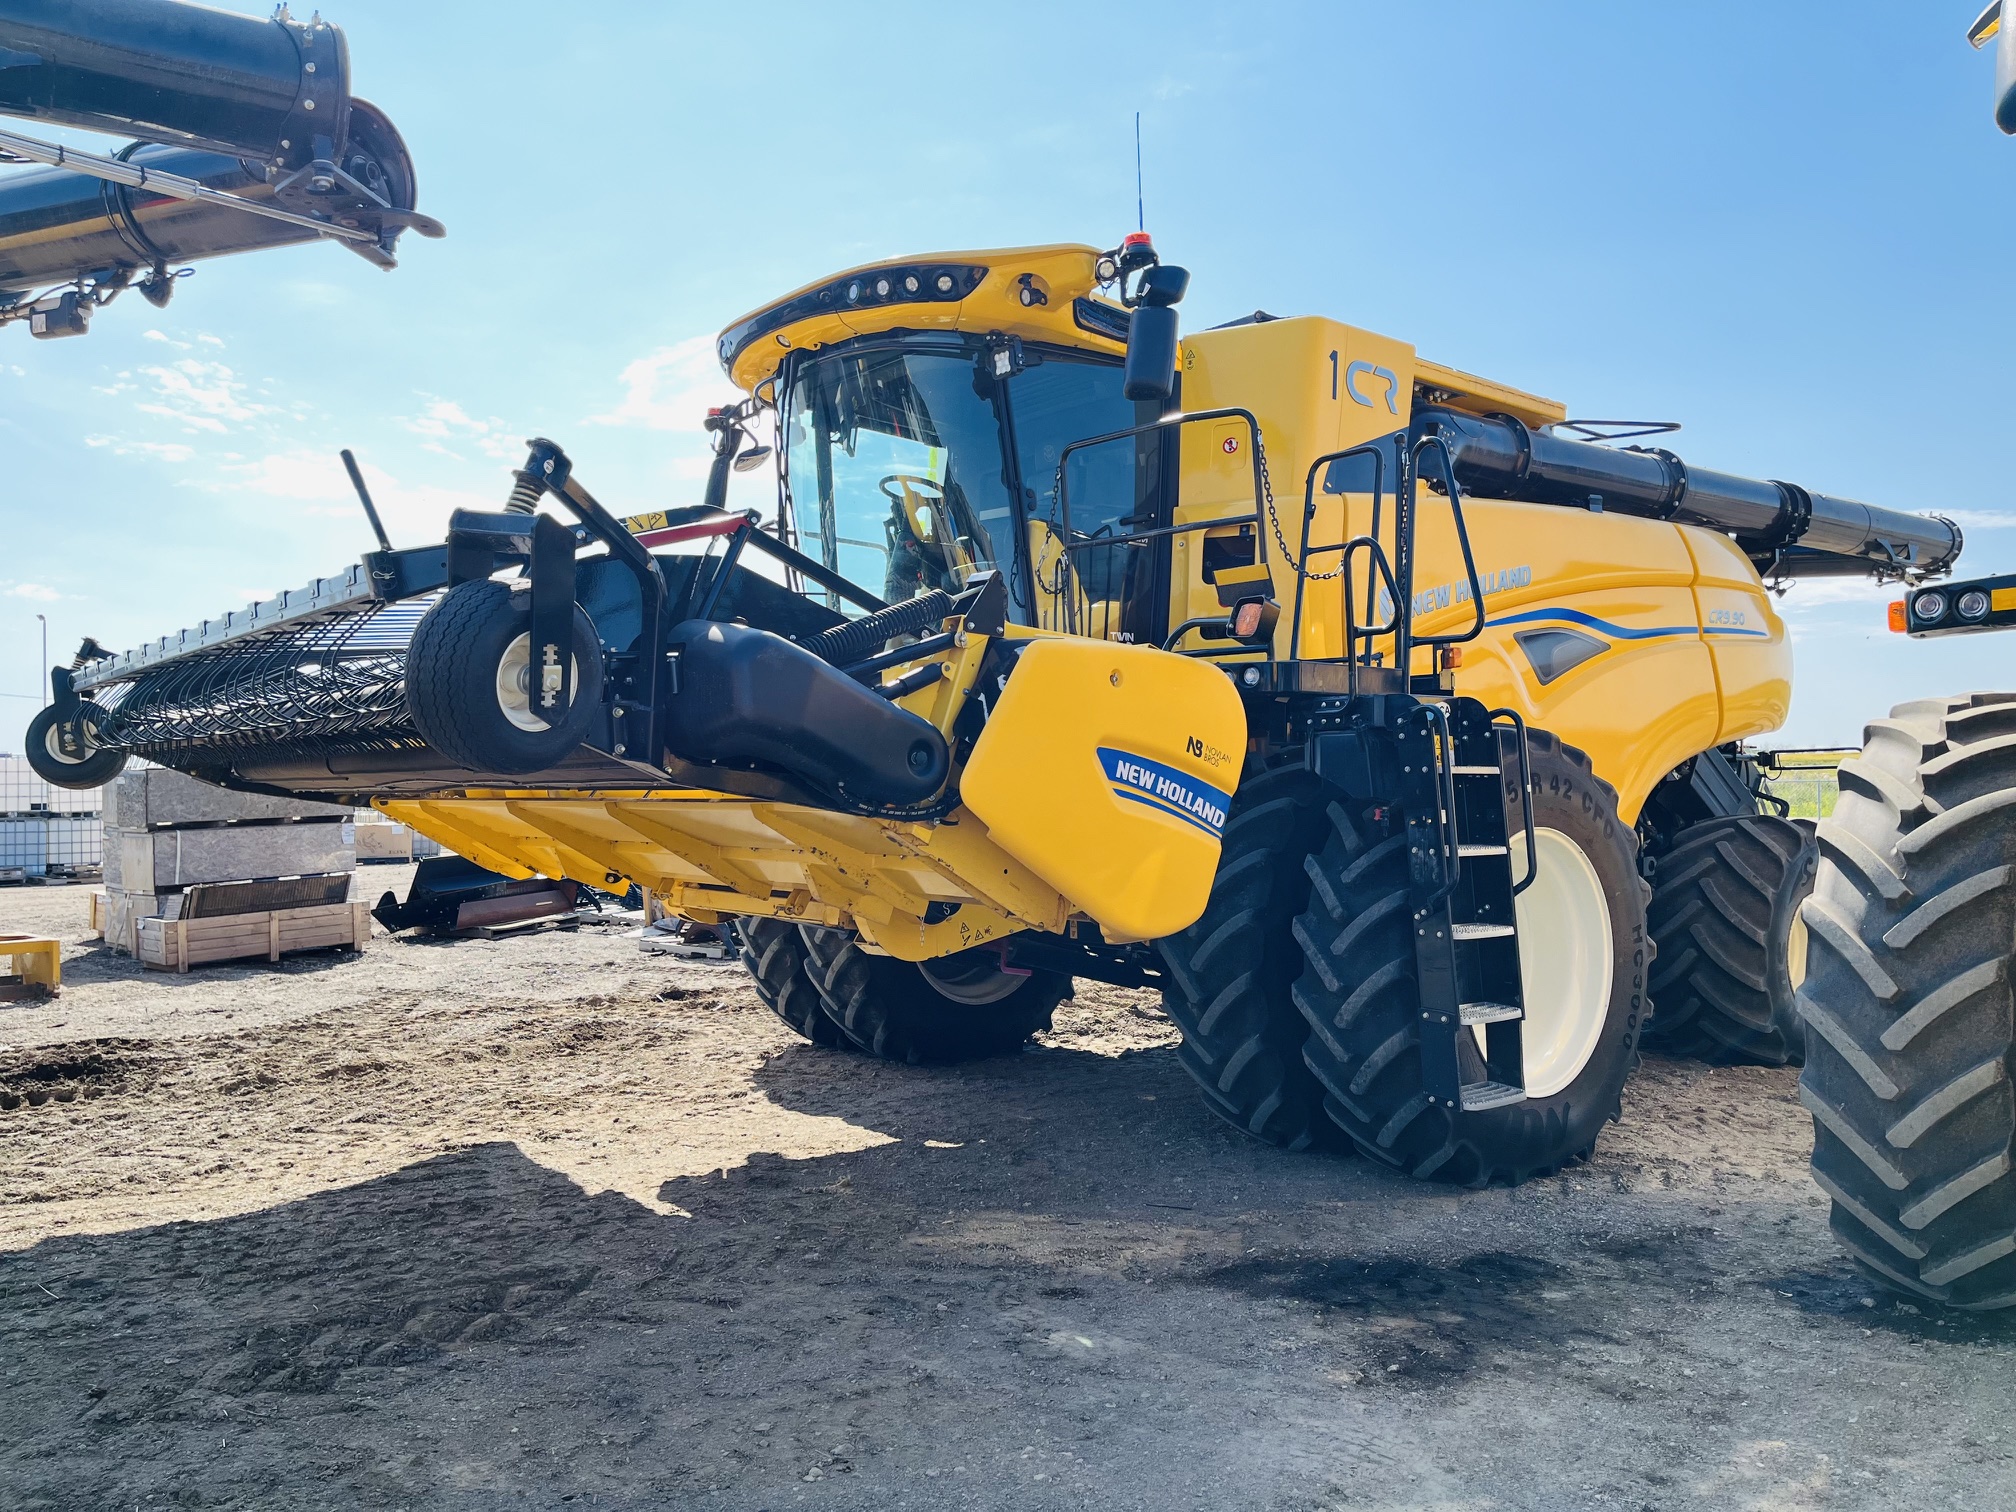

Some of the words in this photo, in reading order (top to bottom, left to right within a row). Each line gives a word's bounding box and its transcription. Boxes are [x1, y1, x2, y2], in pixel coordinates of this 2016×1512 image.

[1346, 360, 1398, 415] CR
[1411, 583, 1451, 618] NEW
[1709, 609, 1745, 626] CR9.90
[1110, 631, 1135, 642] TWIN
[1203, 754, 1220, 768] BROS
[1205, 745, 1232, 764] NOVLAN
[1115, 760, 1156, 790] NEW
[1156, 776, 1226, 829] HOLLAND
[1550, 775, 1573, 801] 42
[1582, 792, 1615, 840] CFO
